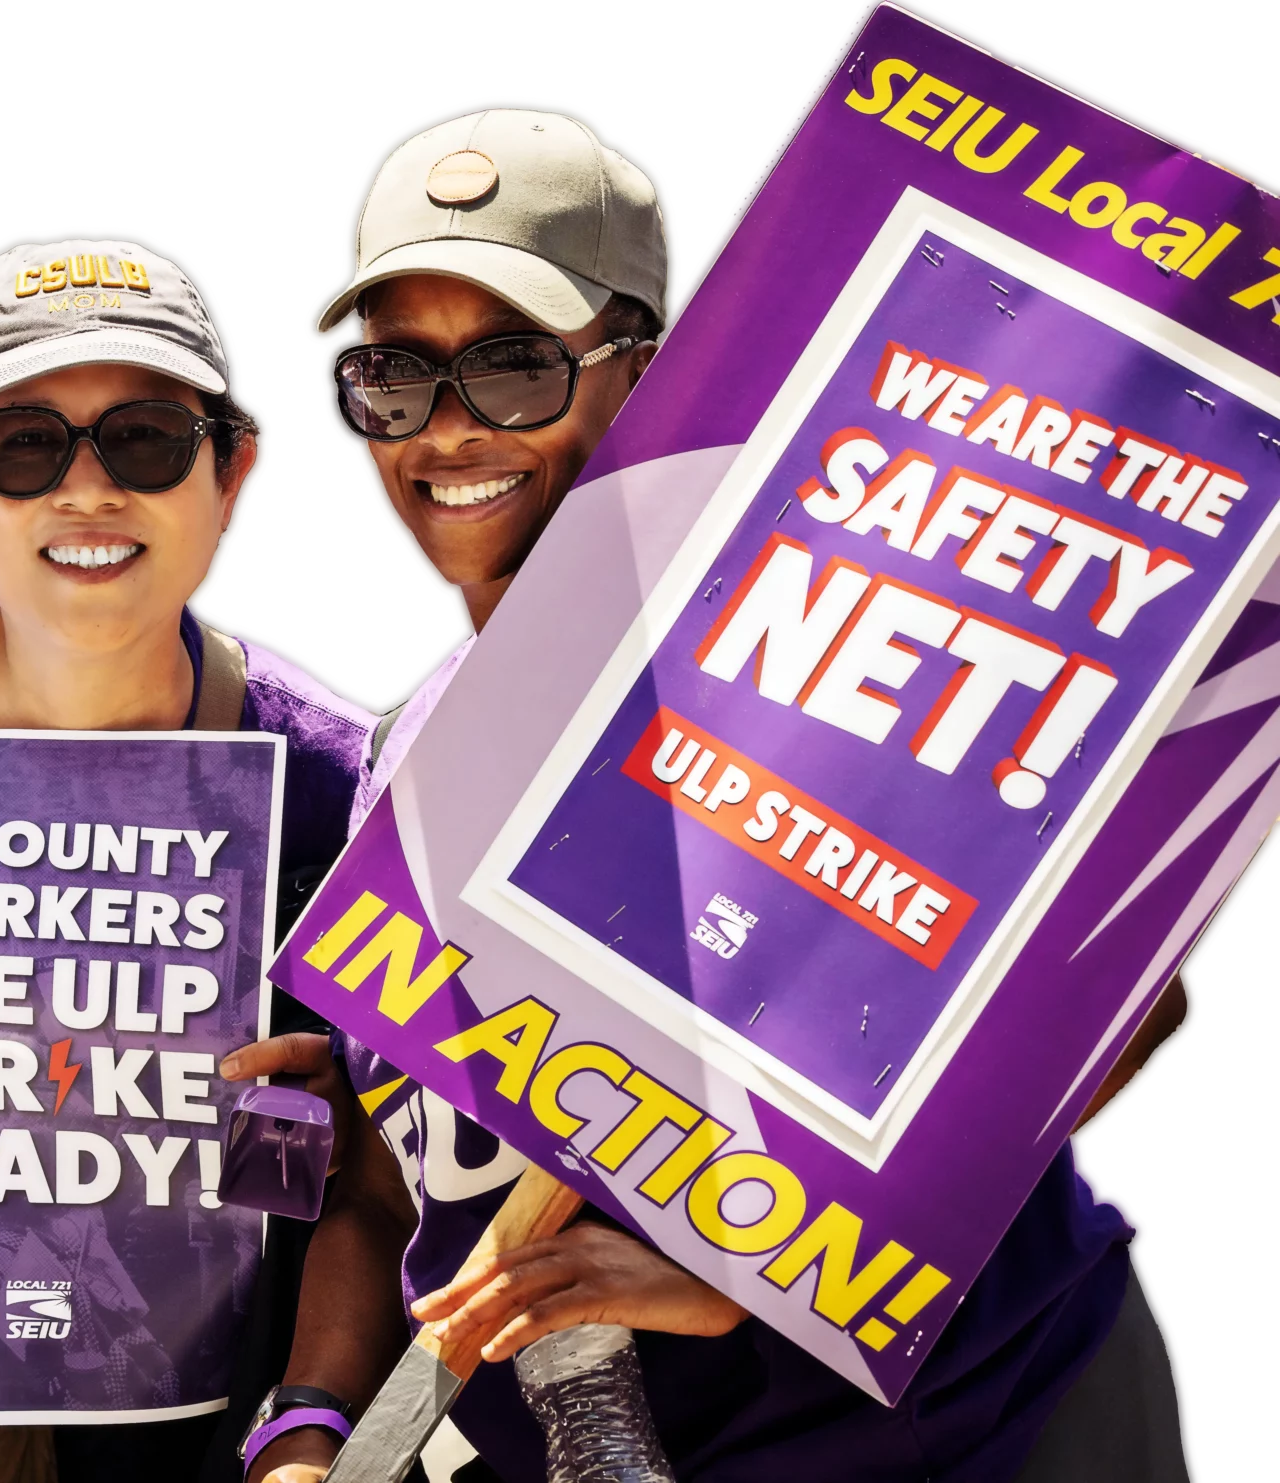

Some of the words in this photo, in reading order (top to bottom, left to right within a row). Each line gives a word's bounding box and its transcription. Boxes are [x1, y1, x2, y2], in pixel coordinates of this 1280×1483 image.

[844, 58, 1040, 174] SEIU
[1023, 145, 1242, 281] Local
[15, 254, 151, 298] CSULB
[48, 292, 122, 313] MOM
[869, 340, 989, 436] WE
[965, 390, 1116, 484] ARE
[1106, 434, 1250, 538] THE
[798, 430, 1195, 640] SAFETY
[696, 536, 1119, 811] NET!
[650, 727, 752, 814] ULP
[742, 790, 951, 945] STRIKE
[689, 924, 740, 960] SEIU
[713, 892, 742, 915] LOCAL
[52, 958, 219, 1034] ULP
[302, 889, 469, 1027] IN
[432, 996, 952, 1353] ACTION!
[6, 1280, 47, 1289] LOCAL
[51, 1281, 71, 1290] 721
[6, 1321, 72, 1339] SEIU
